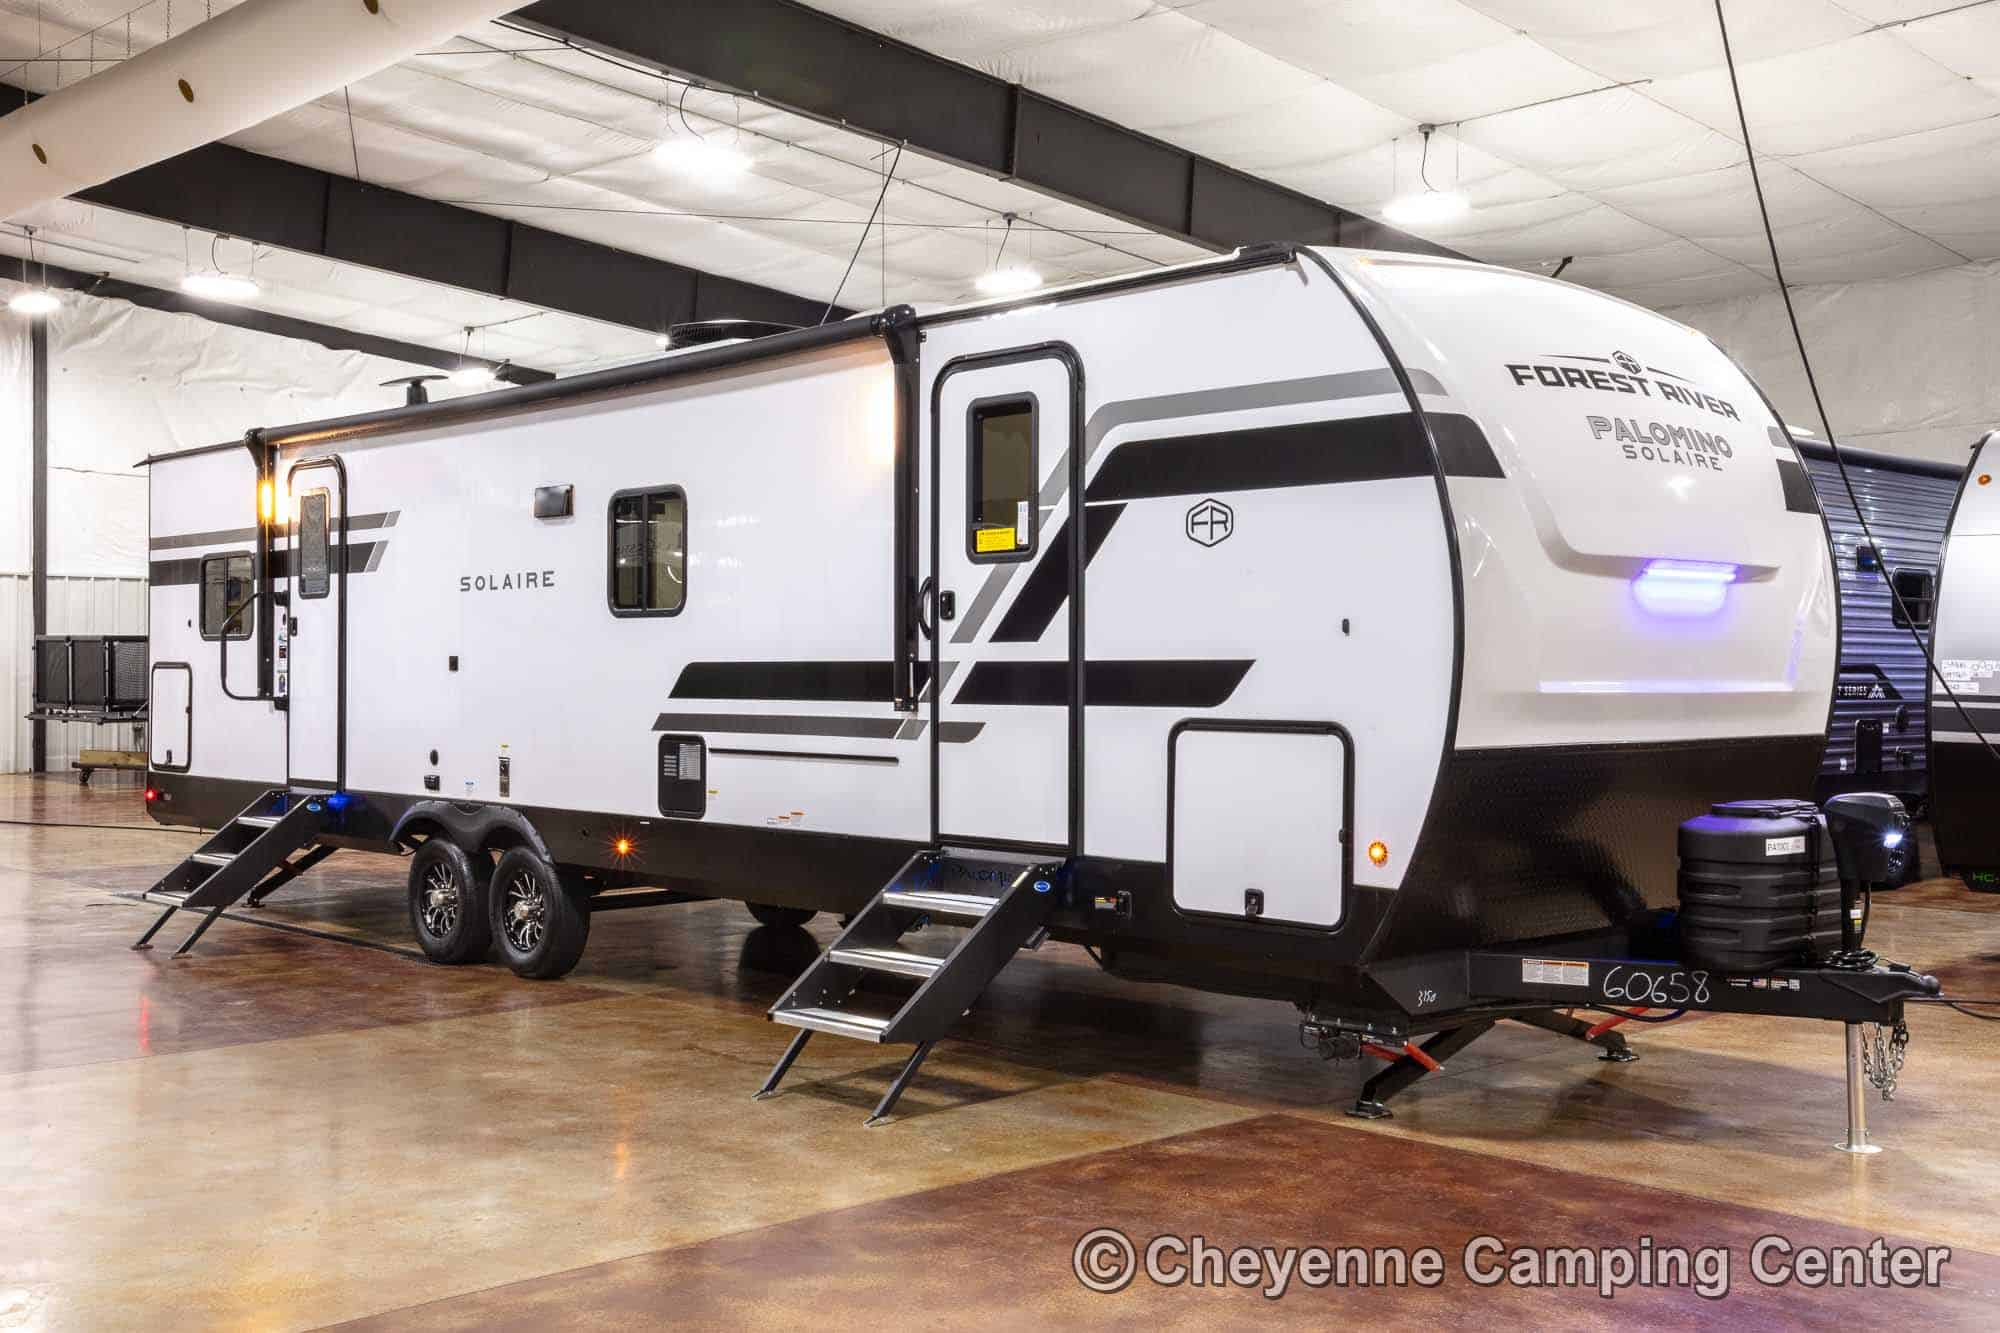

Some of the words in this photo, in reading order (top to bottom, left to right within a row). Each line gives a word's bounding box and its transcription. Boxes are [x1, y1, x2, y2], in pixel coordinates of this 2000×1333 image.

[1504, 364, 1651, 397] FOREST
[1654, 380, 1741, 422] RIVER
[1586, 415, 1733, 459] PALOMINO
[1622, 444, 1723, 472] SOLAIRE
[460, 570, 555, 592] SOLAIRE
[1603, 966, 1711, 1003] 60658
